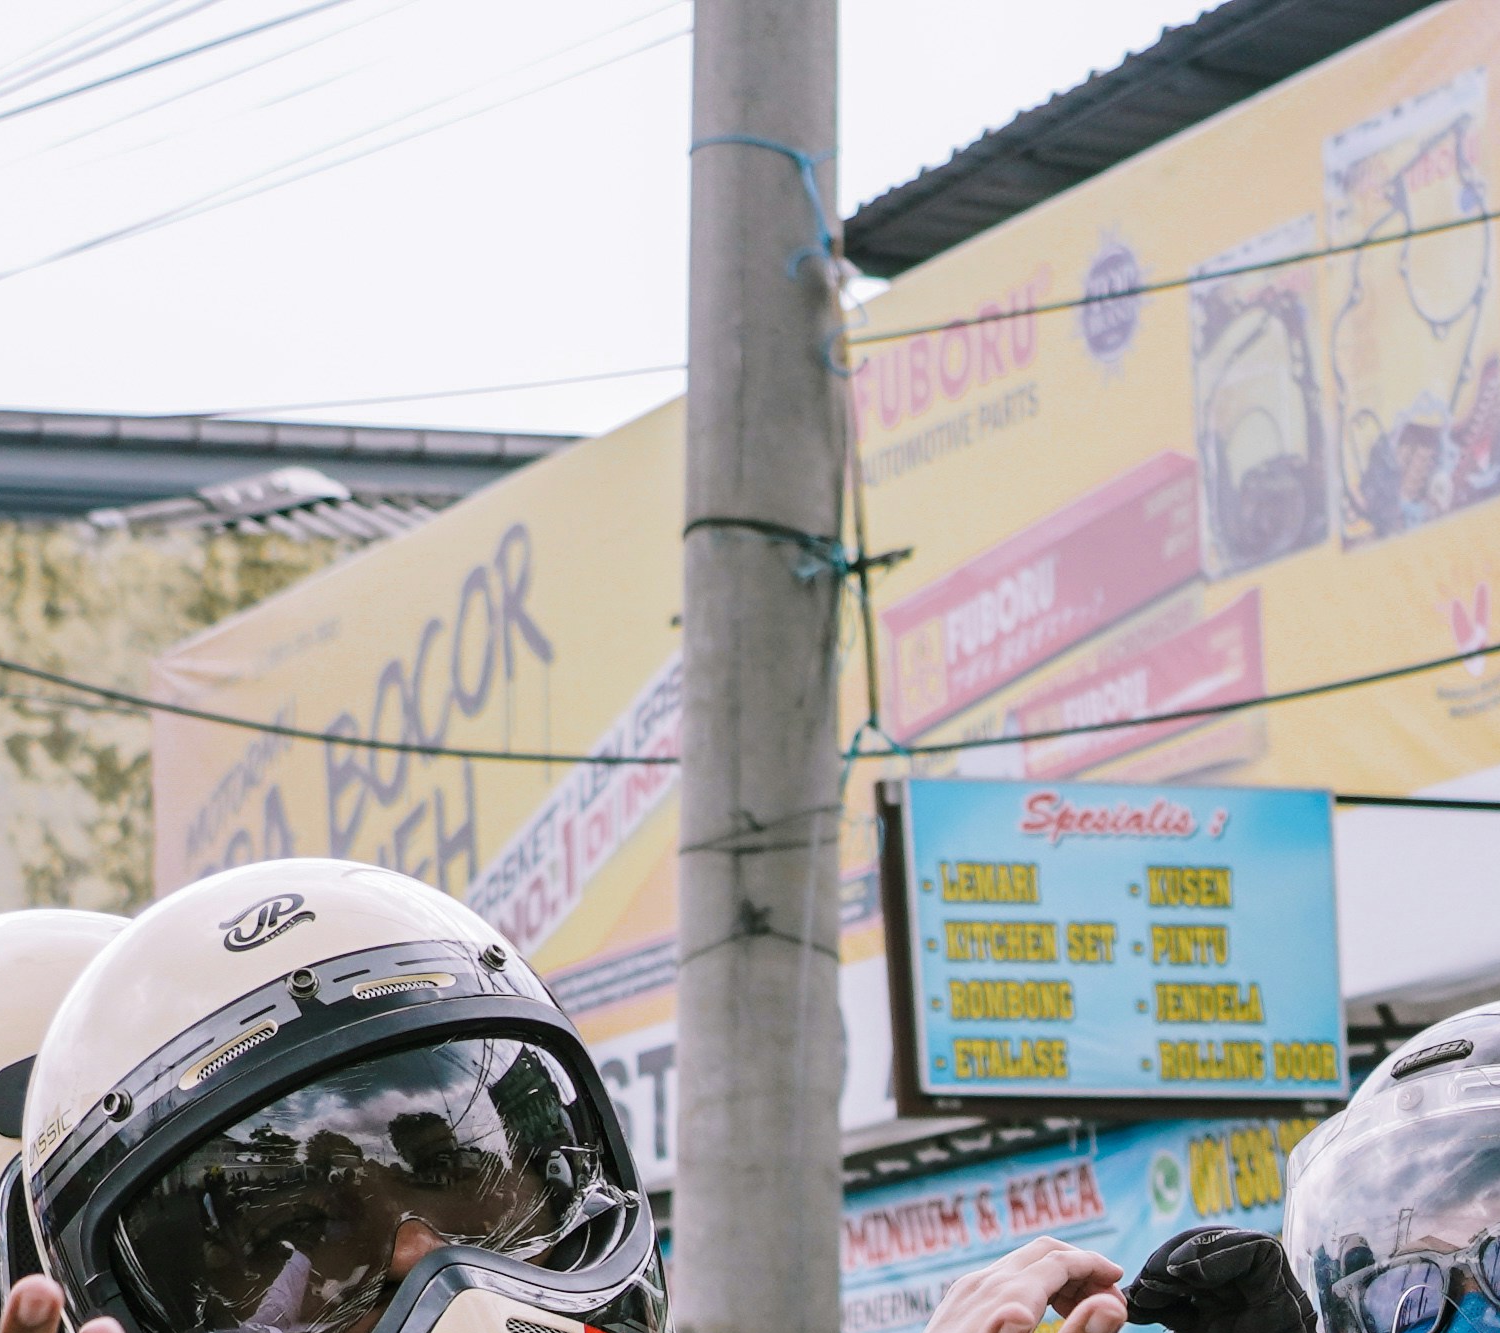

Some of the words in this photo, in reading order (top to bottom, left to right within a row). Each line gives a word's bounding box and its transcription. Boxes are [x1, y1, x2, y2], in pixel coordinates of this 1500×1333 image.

[945, 551, 1060, 665] FUBORU
[321, 522, 555, 858] BOCOR
[1021, 793, 1195, 849] Spesialis
[940, 861, 1041, 904] LEMARI
[1147, 866, 1233, 908] KUSEN
[945, 920, 1058, 963] KITCHEN
[1067, 922, 1118, 963] SET
[1151, 924, 1230, 966] PINTU
[950, 979, 1074, 1021] ROMBONG
[1155, 983, 1264, 1024] JENDELA
[953, 1039, 1069, 1079] ETALASE
[1158, 1041, 1268, 1082] ROLLING
[1274, 1042, 1338, 1083] DOOR
[973, 1182, 1000, 1242] &
[1006, 1155, 1105, 1235] KACA
